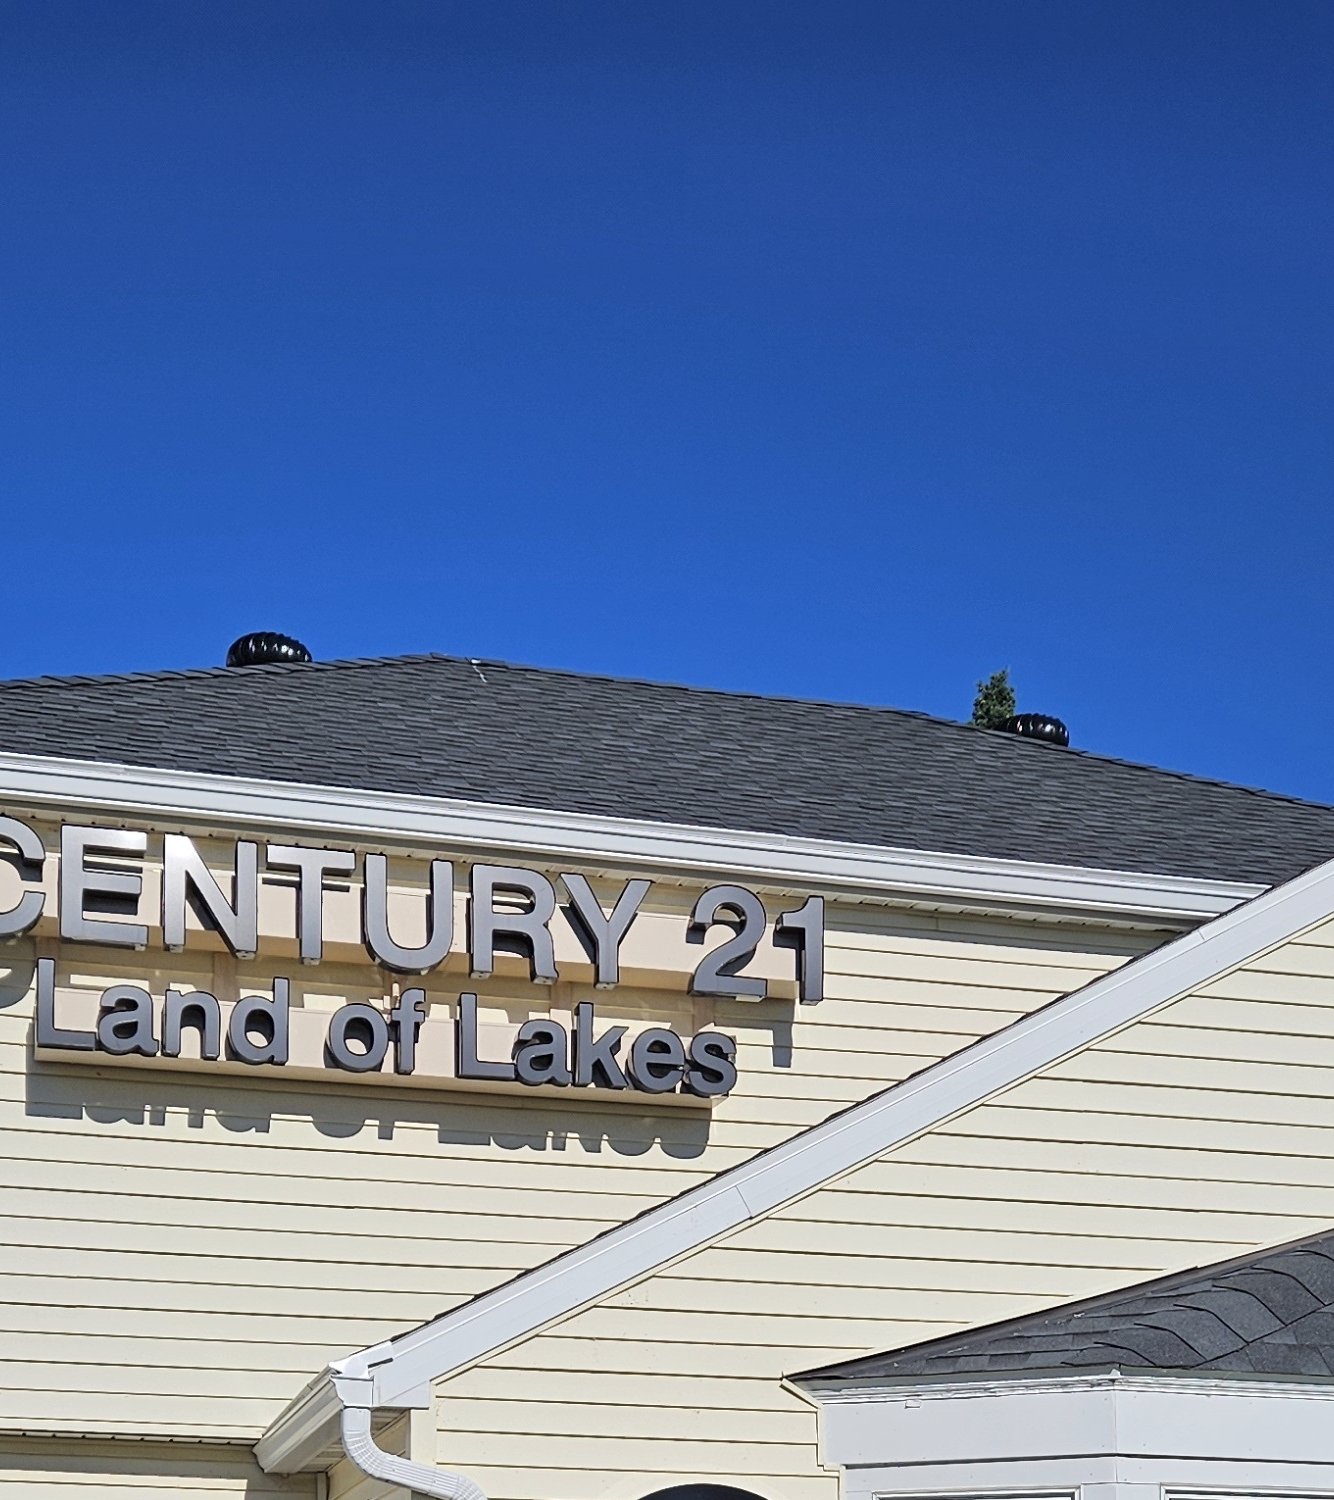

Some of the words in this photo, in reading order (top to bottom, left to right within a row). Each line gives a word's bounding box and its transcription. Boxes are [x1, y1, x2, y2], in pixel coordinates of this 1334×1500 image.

[687, 884, 825, 1006] 21
[36, 957, 289, 1066] Land
[327, 988, 426, 1074] of
[455, 992, 738, 1098] Lakes
